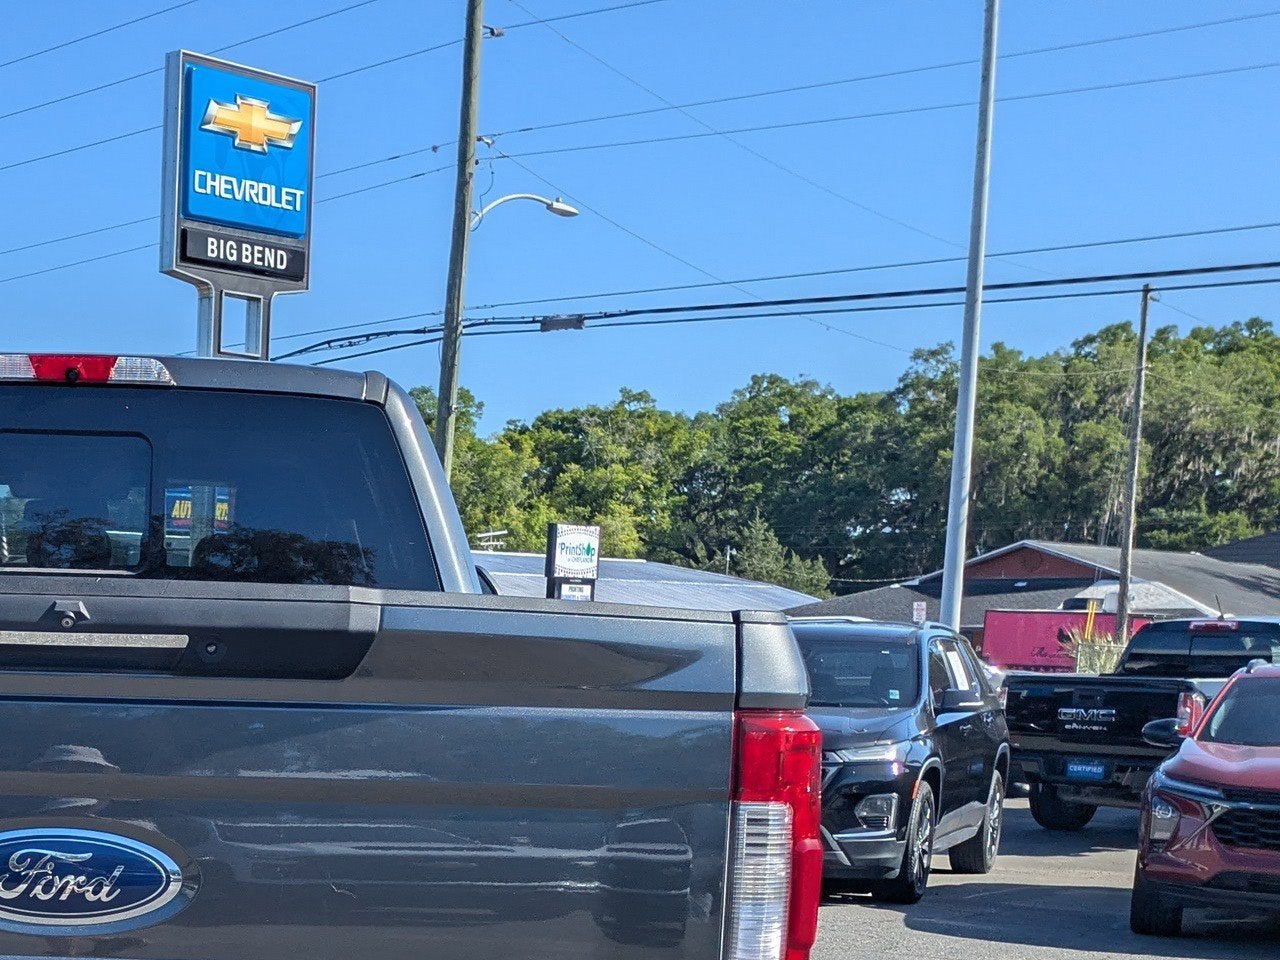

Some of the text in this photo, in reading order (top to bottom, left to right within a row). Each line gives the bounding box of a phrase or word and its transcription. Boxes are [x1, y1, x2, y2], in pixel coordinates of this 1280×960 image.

[193, 170, 304, 211] CHEVROLET
[207, 237, 287, 269] BIG BEND
[1057, 708, 1116, 722] GMC
[1069, 765, 1103, 773] CERTIFIED
